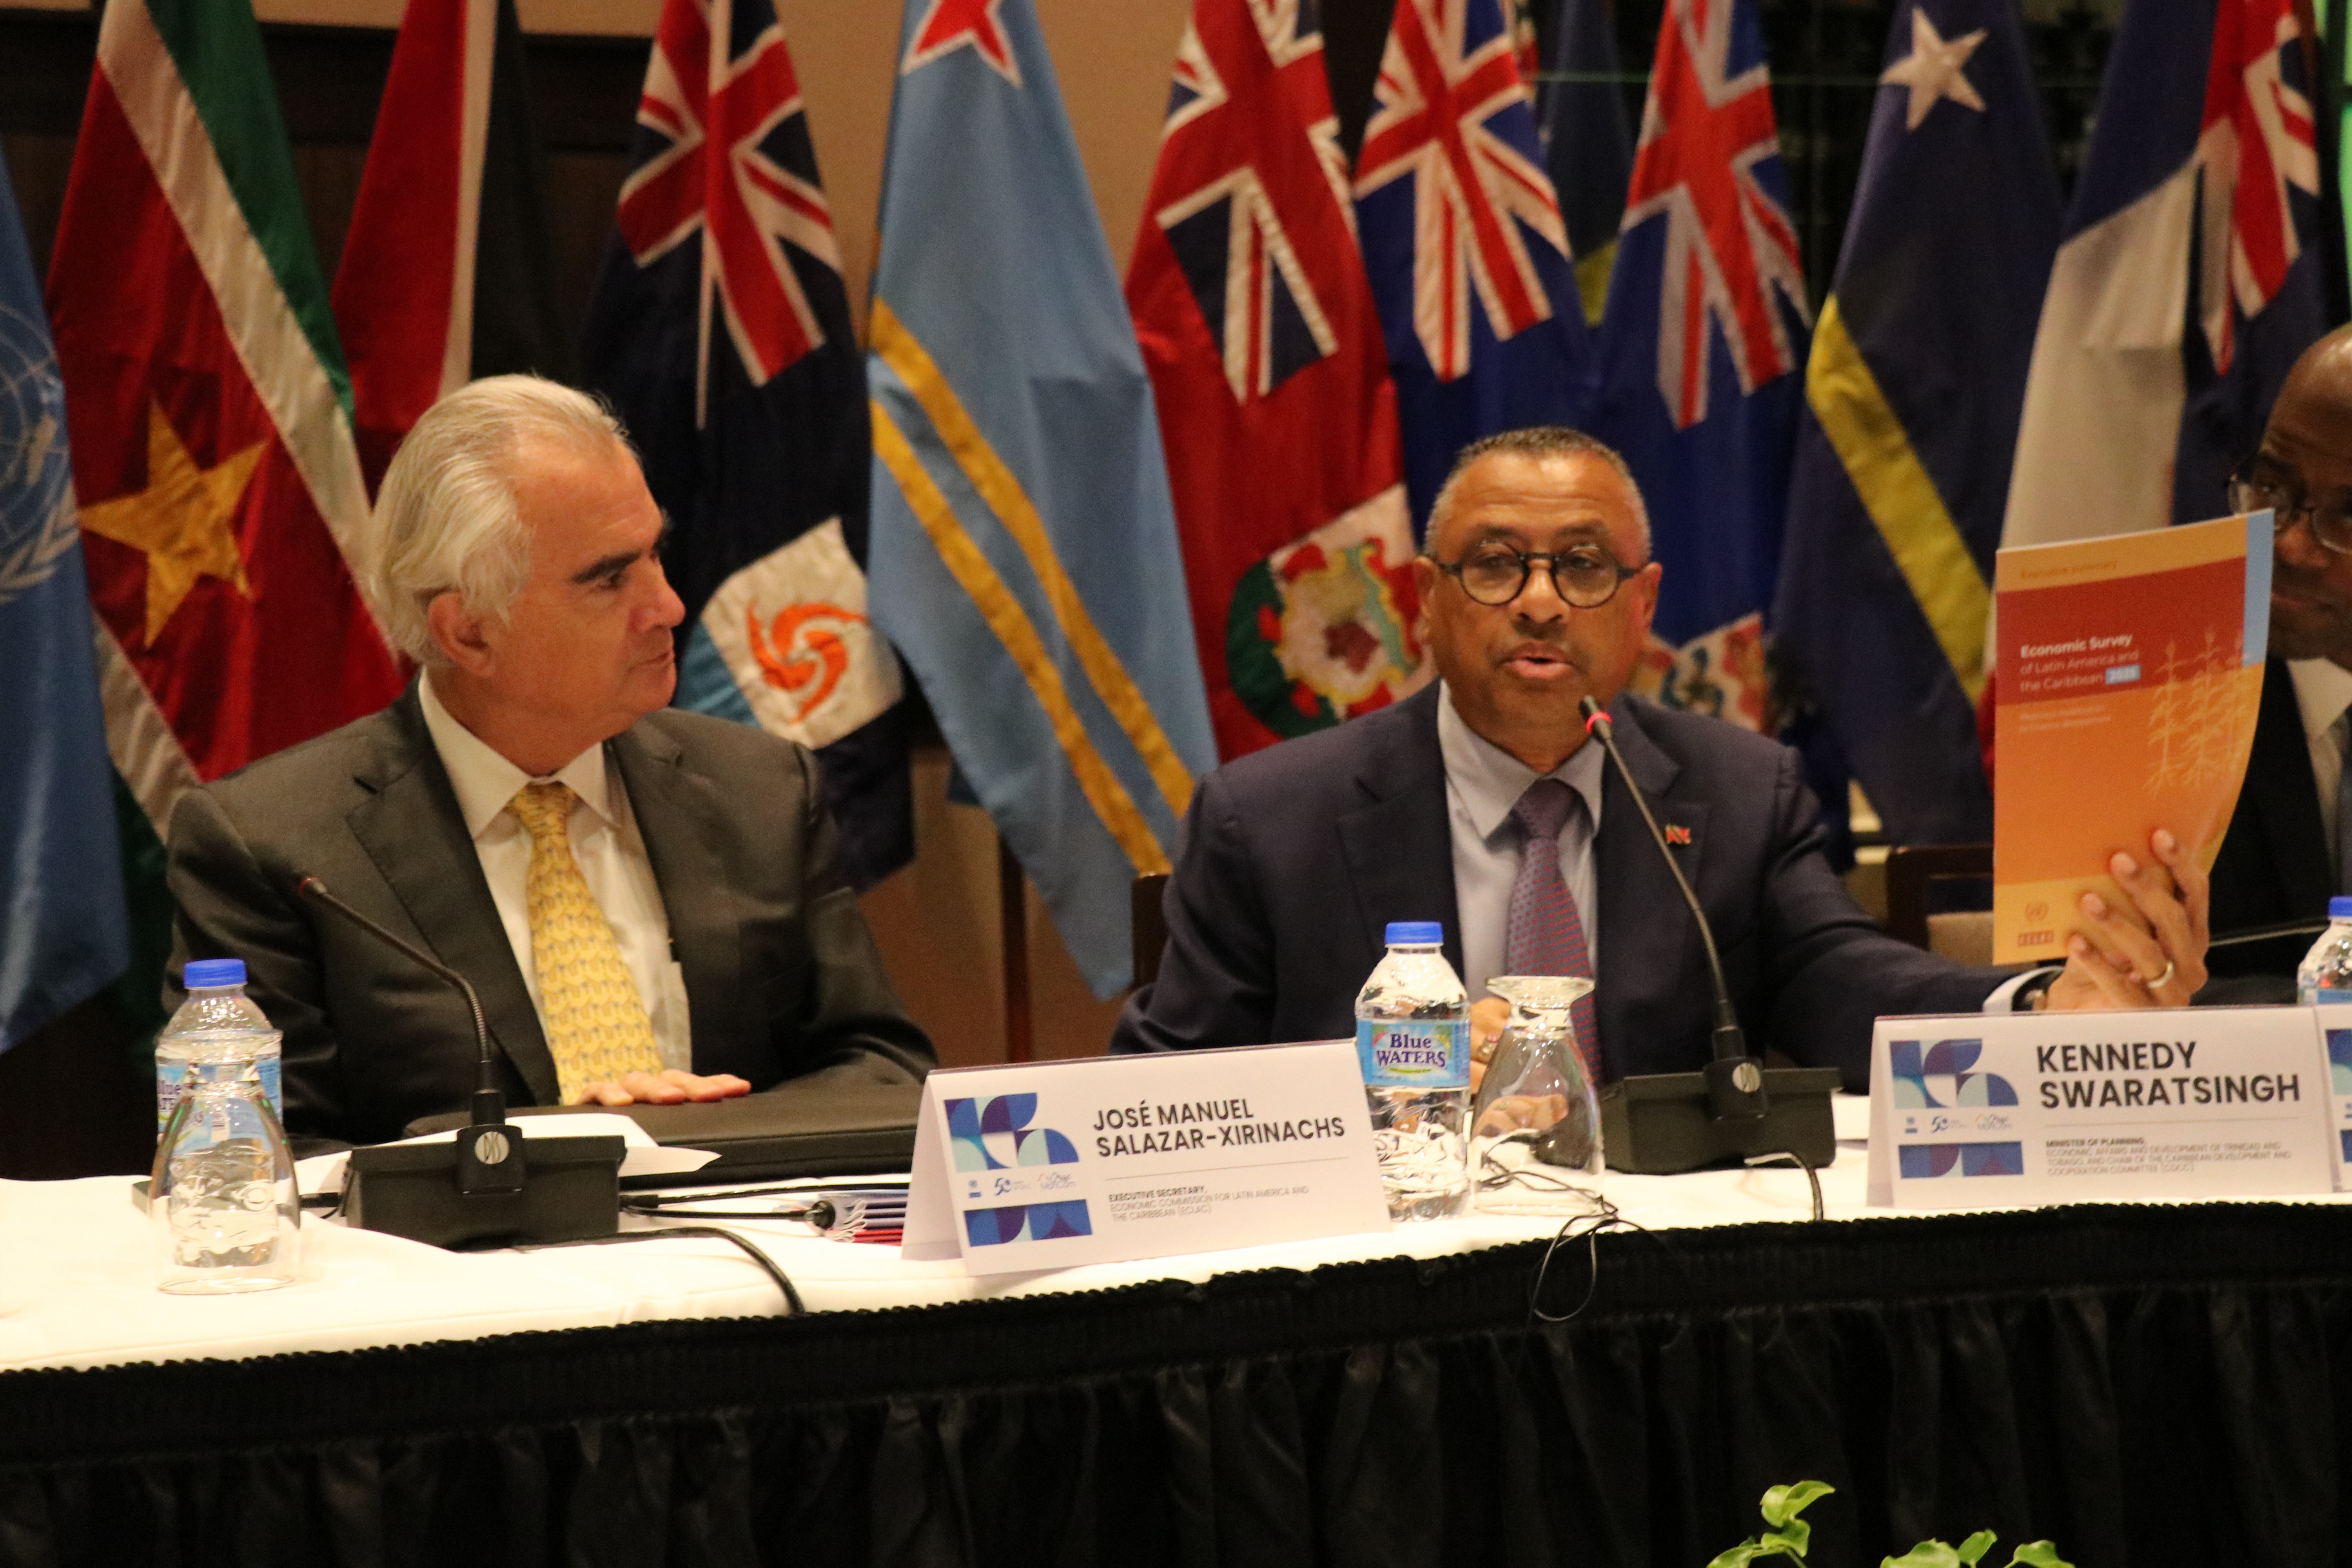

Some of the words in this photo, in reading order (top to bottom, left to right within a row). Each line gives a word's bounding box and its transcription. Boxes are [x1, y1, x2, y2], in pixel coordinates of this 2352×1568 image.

[2020, 639, 2087, 659] Economic
[2089, 634, 2132, 651] Survey
[2020, 662, 2033, 674] of
[2035, 661, 2065, 674] Latin
[1390, 1033, 1432, 1048] Blue
[1376, 1050, 1446, 1068] WATERS
[2037, 1041, 2196, 1073] KENNEDY
[2040, 1074, 2300, 1109] SWARATSINGH
[1094, 1099, 1152, 1131] JOSÉ
[1157, 1098, 1254, 1125] MANUEL
[1096, 1116, 1345, 1157] SALAZAR-XIRINACHS
[1109, 1190, 1155, 1202] EXECUTIVE
[1110, 1200, 1156, 1212] ECONOMIC
[1158, 1195, 1213, 1207] COMMISSION
[1215, 1192, 1230, 1202] FOR
[1232, 1190, 1254, 1200] LATIN
[1255, 1187, 1290, 1198] AMERICA
[1292, 1185, 1309, 1194] AND
[1113, 1212, 1128, 1222] THE
[1129, 1208, 1176, 1220] CARIBBEAN
